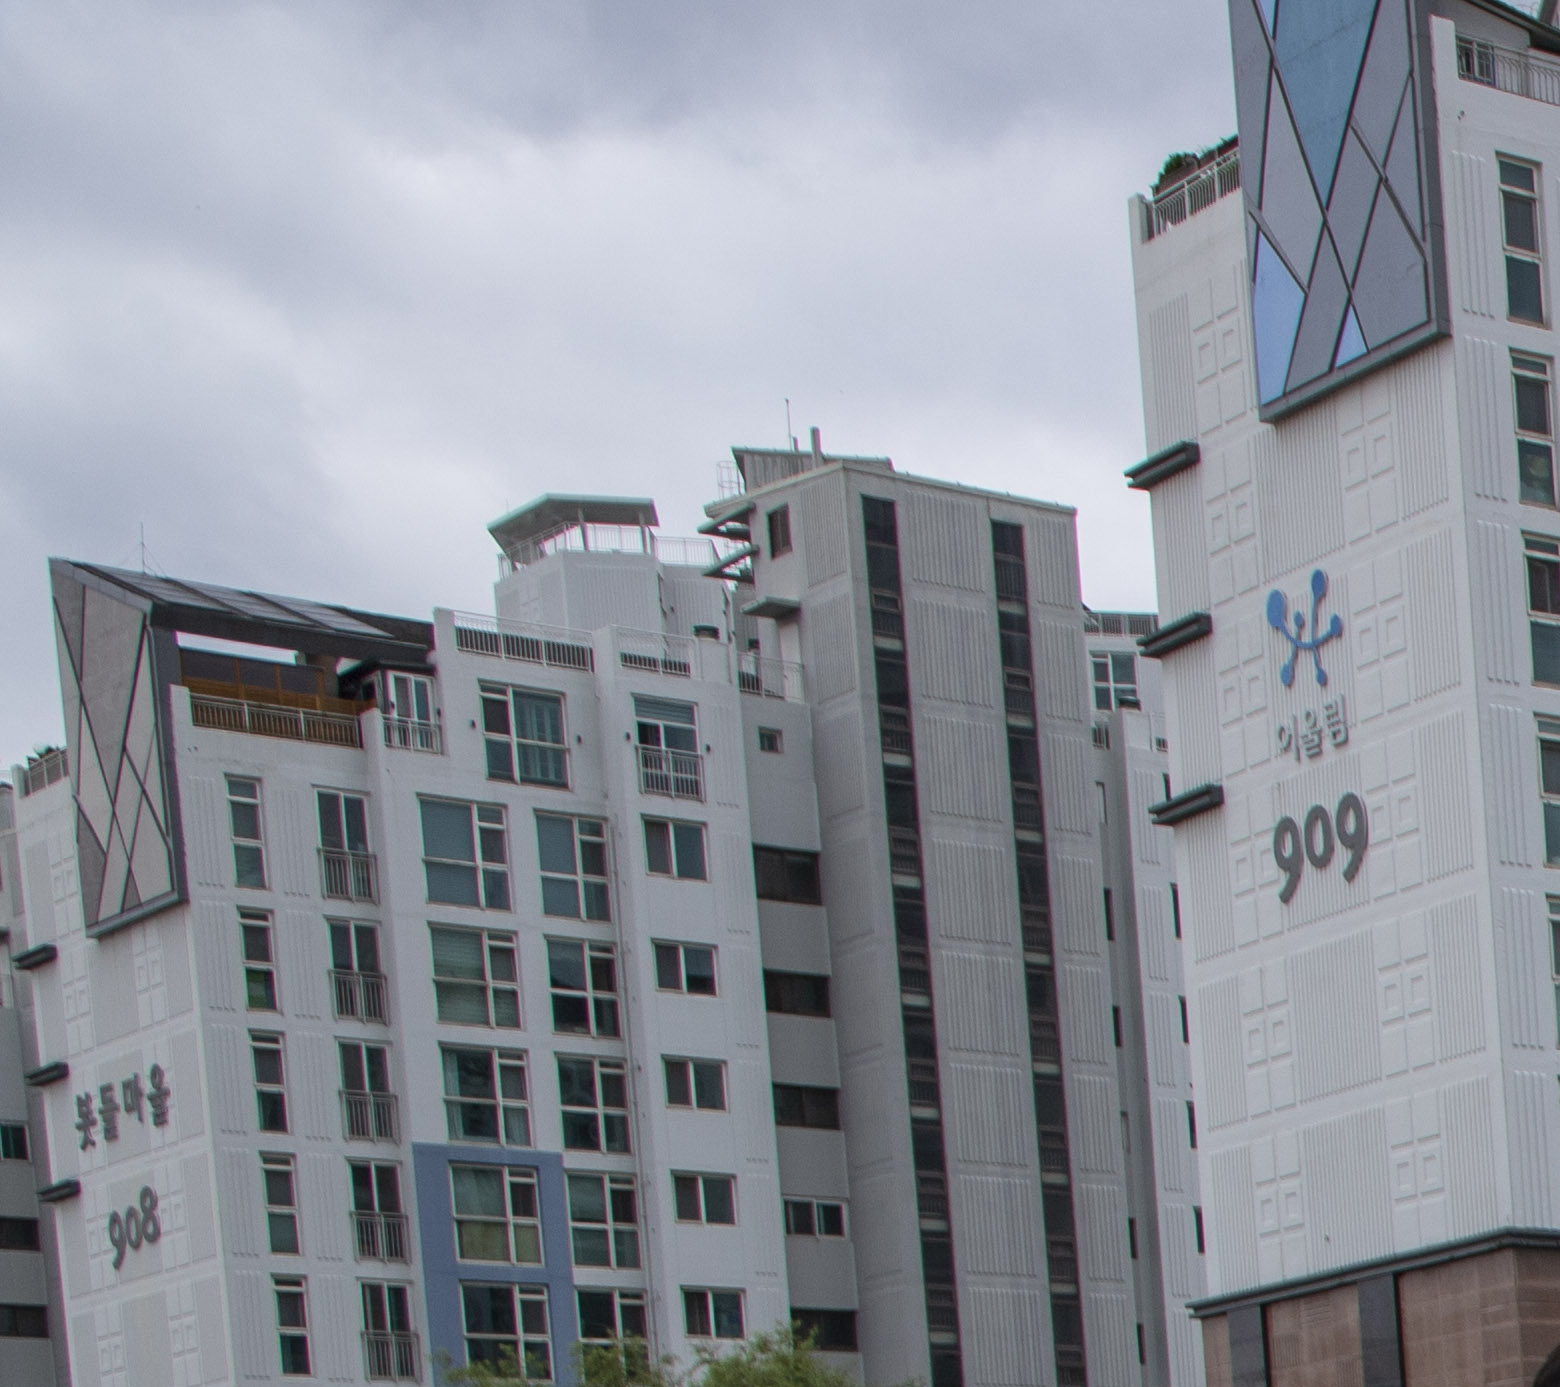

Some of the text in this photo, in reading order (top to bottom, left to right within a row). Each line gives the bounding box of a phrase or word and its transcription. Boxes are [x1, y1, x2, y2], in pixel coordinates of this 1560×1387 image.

[1275, 692, 1350, 763] 어울림
[1273, 791, 1369, 904] 909
[75, 1063, 172, 1151] 봇들마을
[108, 1184, 162, 1271] 908
